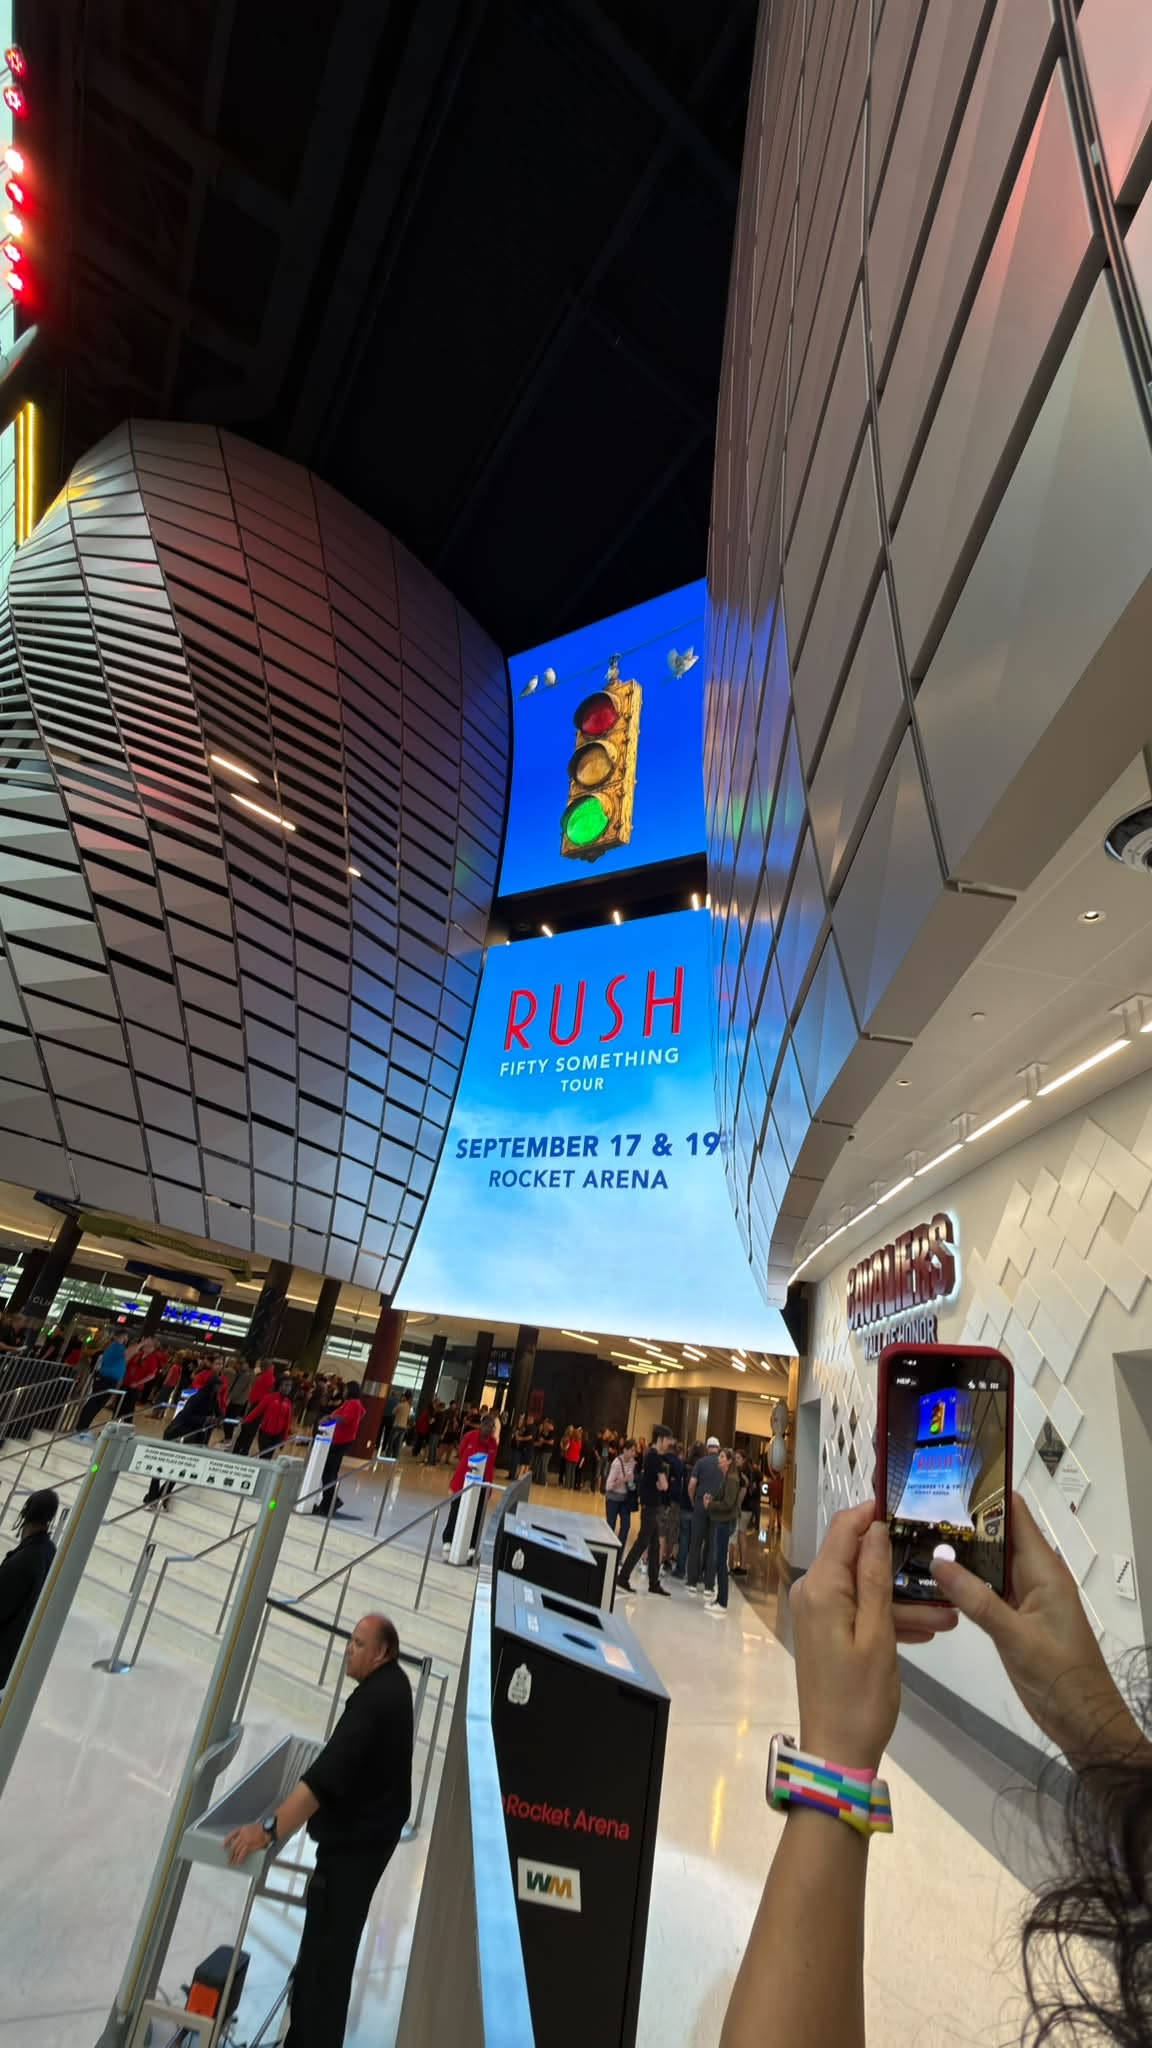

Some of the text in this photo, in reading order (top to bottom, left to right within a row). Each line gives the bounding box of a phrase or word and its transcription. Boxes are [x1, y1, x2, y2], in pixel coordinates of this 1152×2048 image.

[504, 966, 684, 1051] RUSH
[500, 1048, 679, 1077] FIFTY SOMETHING
[560, 1077, 604, 1092] TOUR
[455, 1131, 721, 1159] SEPTEMBER 17 & 19
[488, 1169, 668, 1190] ROCKET ARENA
[847, 1213, 956, 1330] CAVALIERS
[898, 1315, 938, 1344] HONOR
[506, 1793, 630, 1840] Rocket Arena
[526, 1869, 573, 1900] WM
